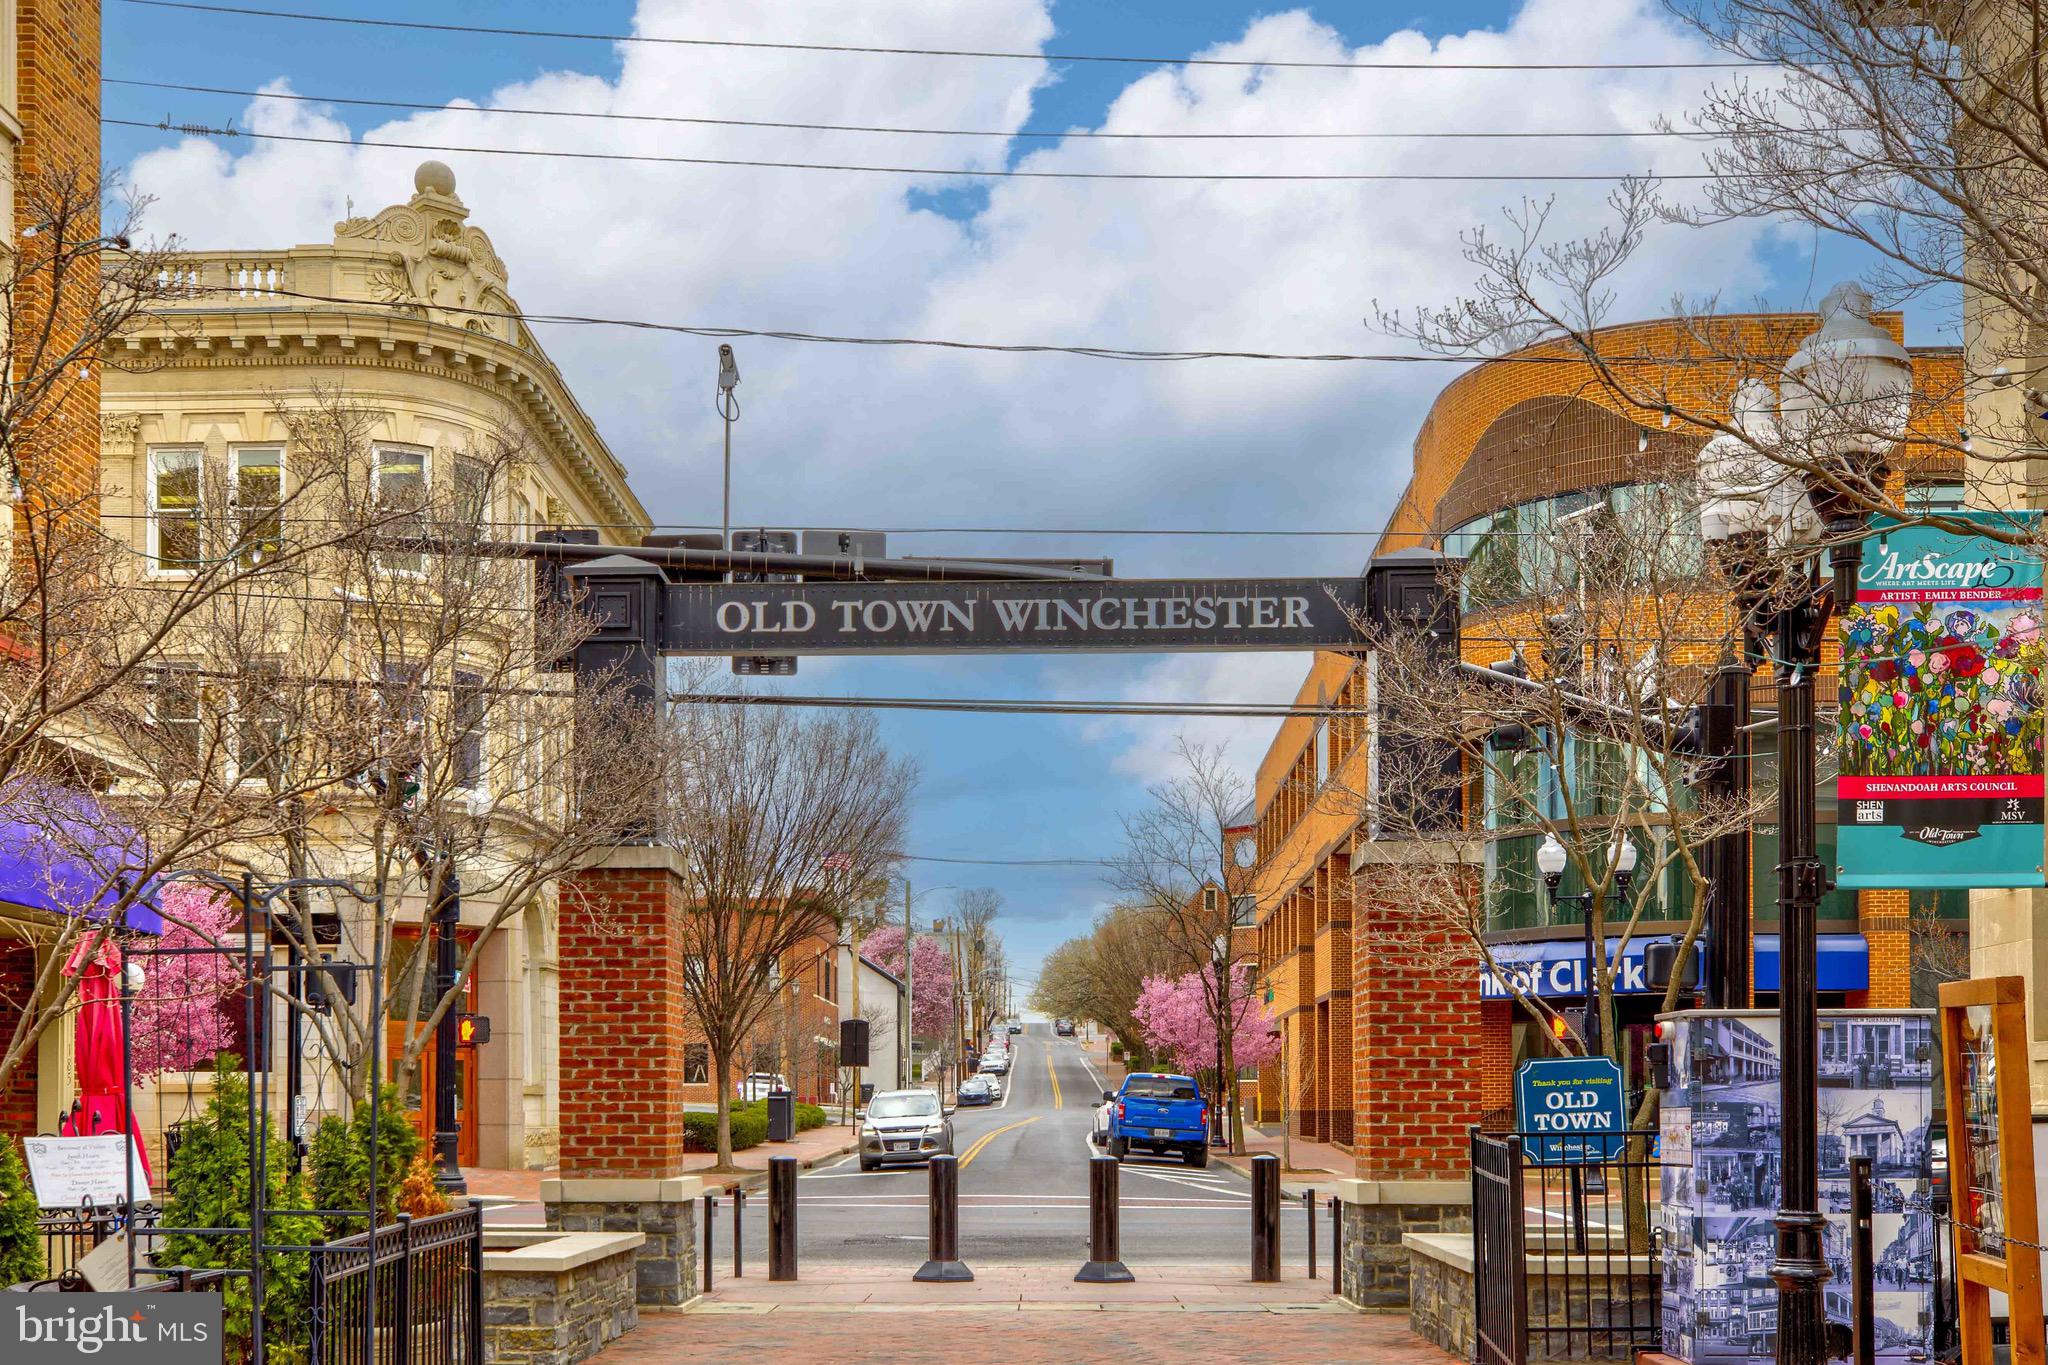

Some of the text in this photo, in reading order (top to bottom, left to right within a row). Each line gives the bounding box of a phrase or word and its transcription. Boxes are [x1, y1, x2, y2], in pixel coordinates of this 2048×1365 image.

[1858, 551, 1997, 587] ArtScape
[1880, 590, 2002, 600] ARTIST: EMILY BENDER
[716, 596, 1315, 633] OLD TOWN WINCHESTER
[1866, 782, 2018, 793] SHENANDOAH ARTS COUNCIL
[1856, 800, 1884, 809] SHEN
[1858, 811, 1882, 820] arts
[2001, 811, 2026, 820] MSV
[1919, 826, 1964, 841] Old Town
[1511, 961, 1543, 994] of
[1545, 1091, 1599, 1110] OLD
[1534, 1111, 1612, 1131] TOWN
